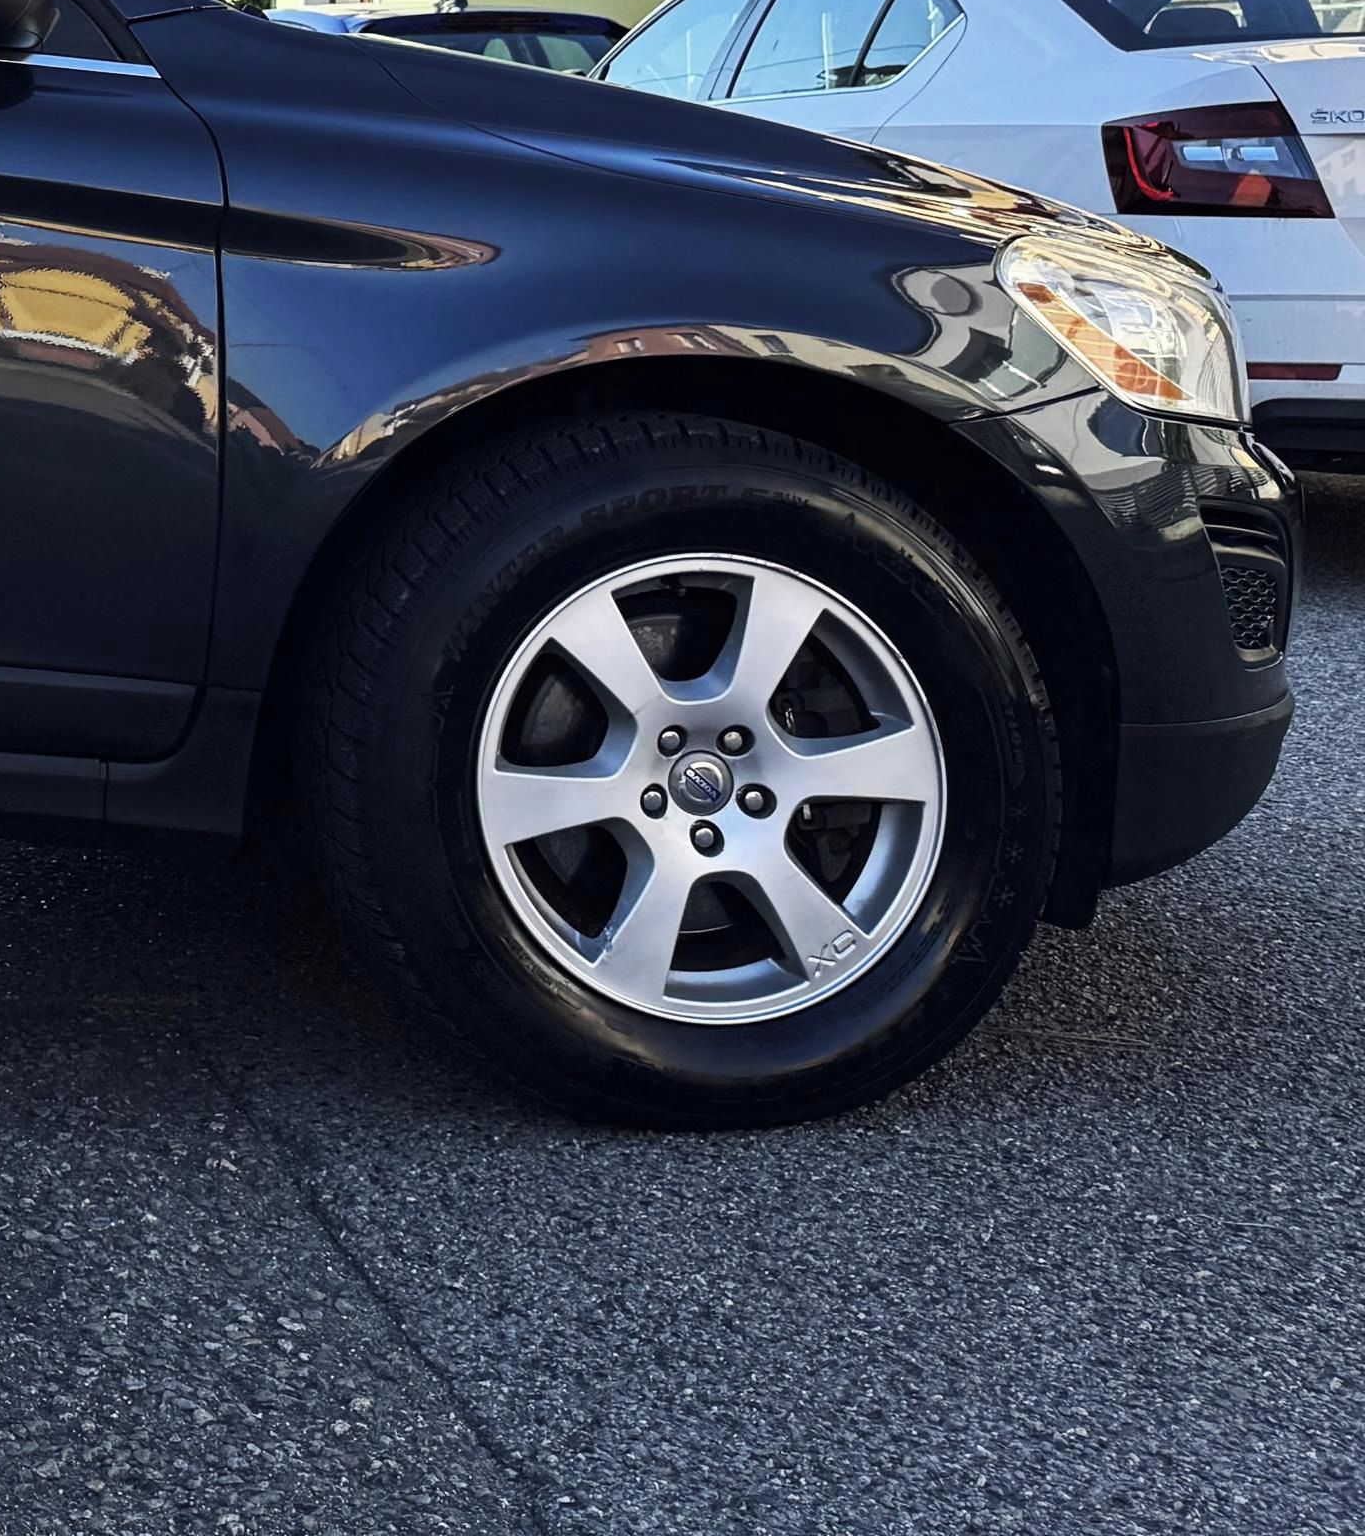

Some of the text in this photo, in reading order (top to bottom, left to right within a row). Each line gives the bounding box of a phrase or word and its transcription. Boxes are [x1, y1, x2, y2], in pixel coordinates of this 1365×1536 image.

[580, 484, 728, 530] SPORT
[685, 768, 718, 800] VOLVO
[807, 930, 857, 978] XC
